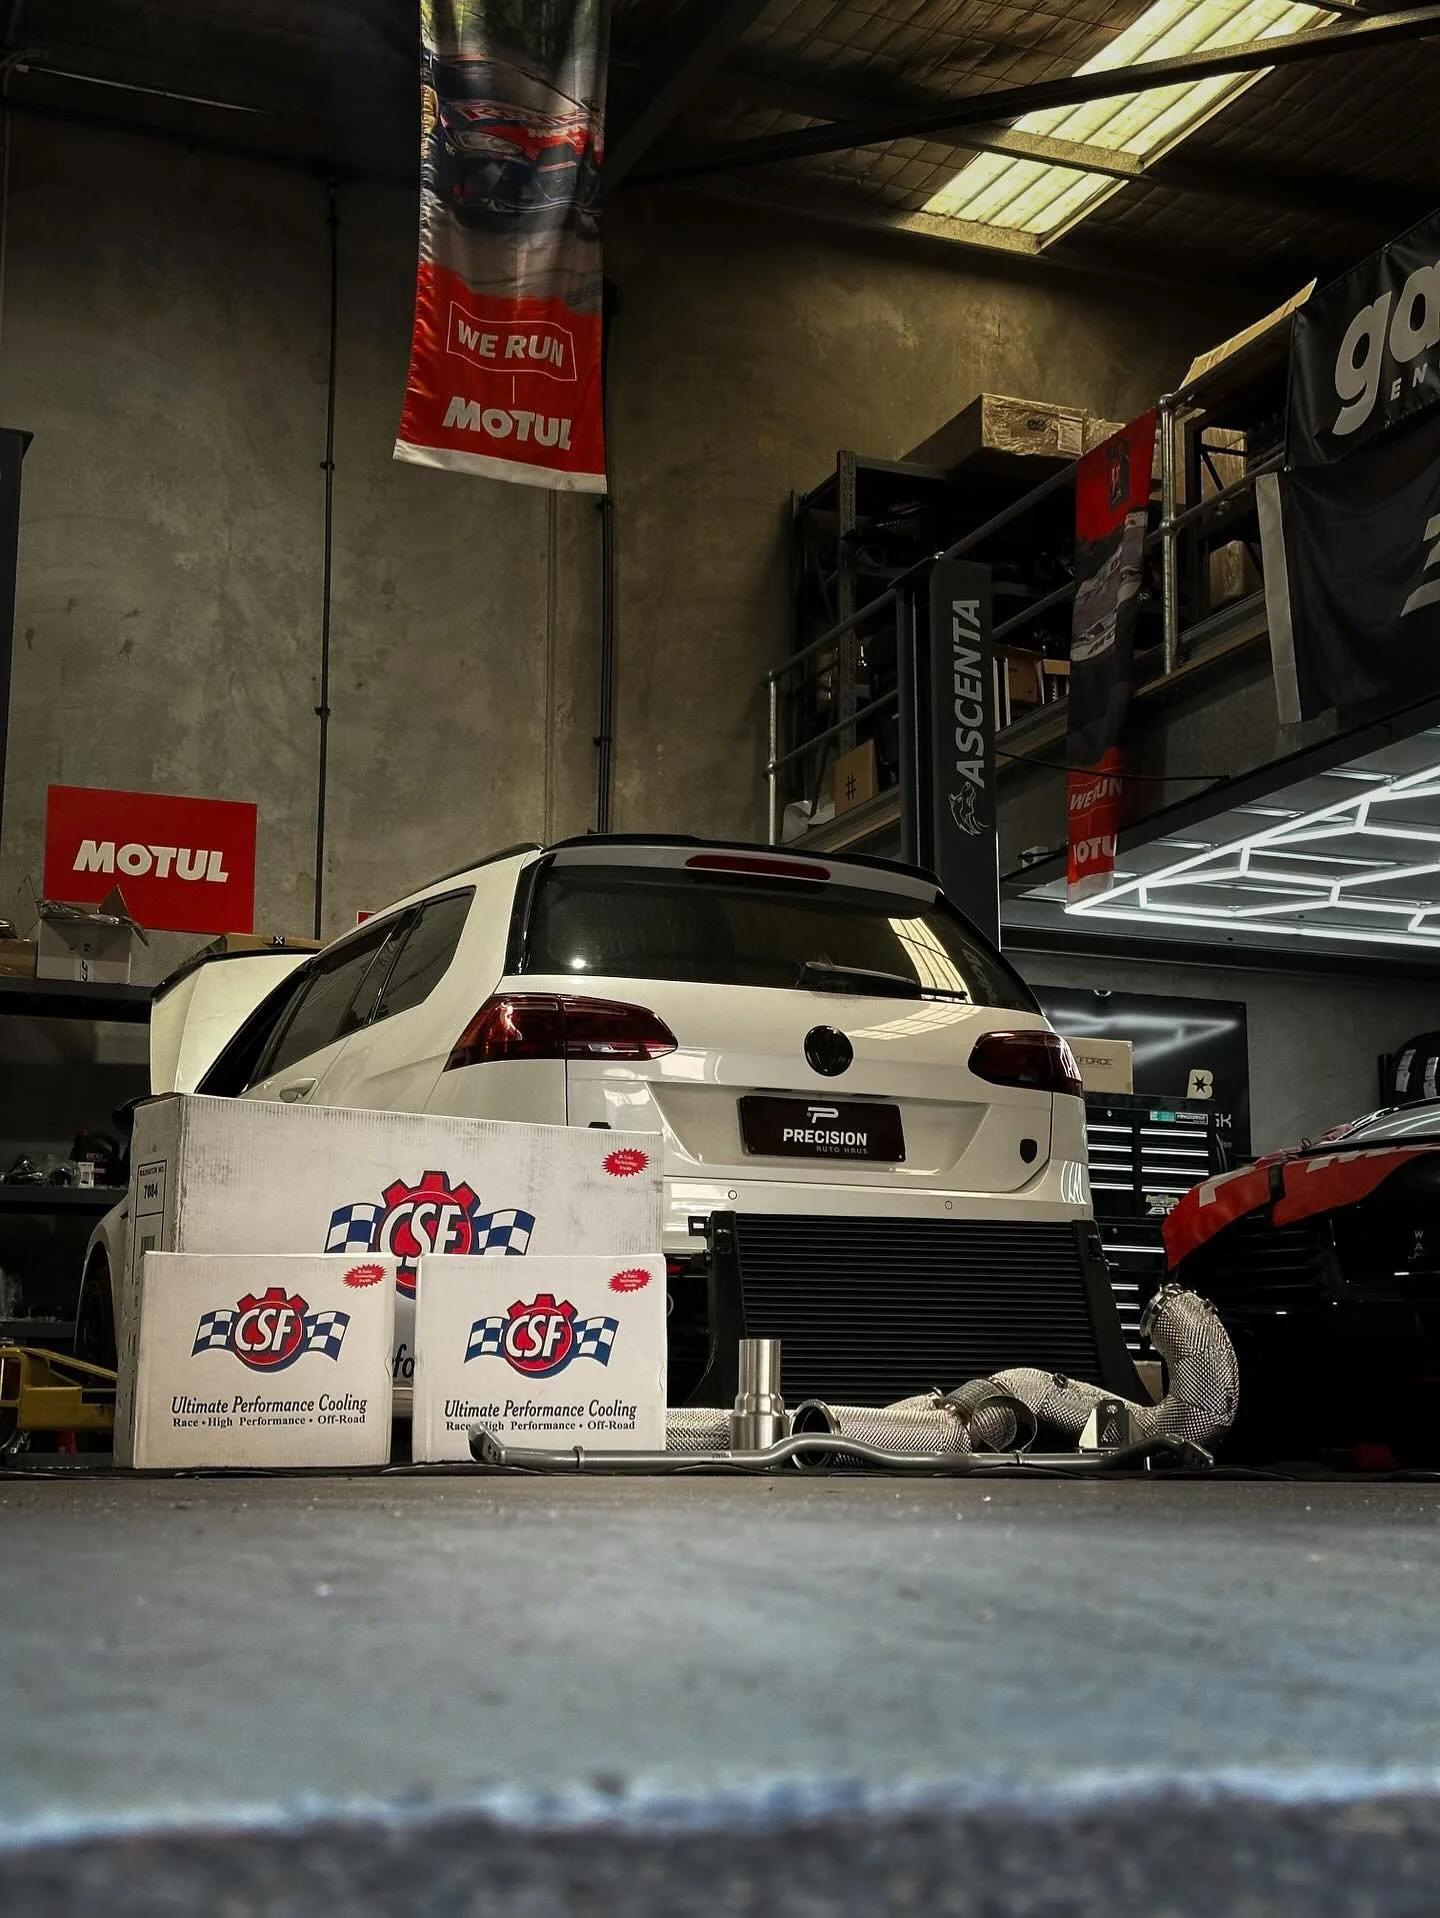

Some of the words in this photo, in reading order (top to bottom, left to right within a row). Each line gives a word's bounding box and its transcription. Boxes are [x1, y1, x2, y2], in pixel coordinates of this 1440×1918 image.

[458, 319, 499, 358] WE
[504, 335, 564, 368] RUN
[442, 395, 572, 451] MOTUL
[952, 599, 985, 788] ASCENTA
[73, 840, 229, 882] MOTUL
[783, 1128, 867, 1146] PRECISION
[379, 1201, 462, 1268] CSF
[235, 1308, 295, 1351] CSF
[505, 1314, 565, 1358] CSF
[171, 1396, 229, 1414] Ultimate
[231, 1395, 315, 1413] Performance
[318, 1393, 368, 1413] Cooling
[173, 1418, 199, 1427] Race
[208, 1417, 233, 1428] High
[240, 1416, 306, 1426] Performance
[317, 1414, 366, 1425] Off-Road
[444, 1400, 500, 1417] Ultimate
[503, 1400, 585, 1417] Performance
[589, 1399, 638, 1420] Cooling
[446, 1421, 471, 1431] Race
[511, 1420, 576, 1431] Performance
[587, 1420, 636, 1430] Off-Road
